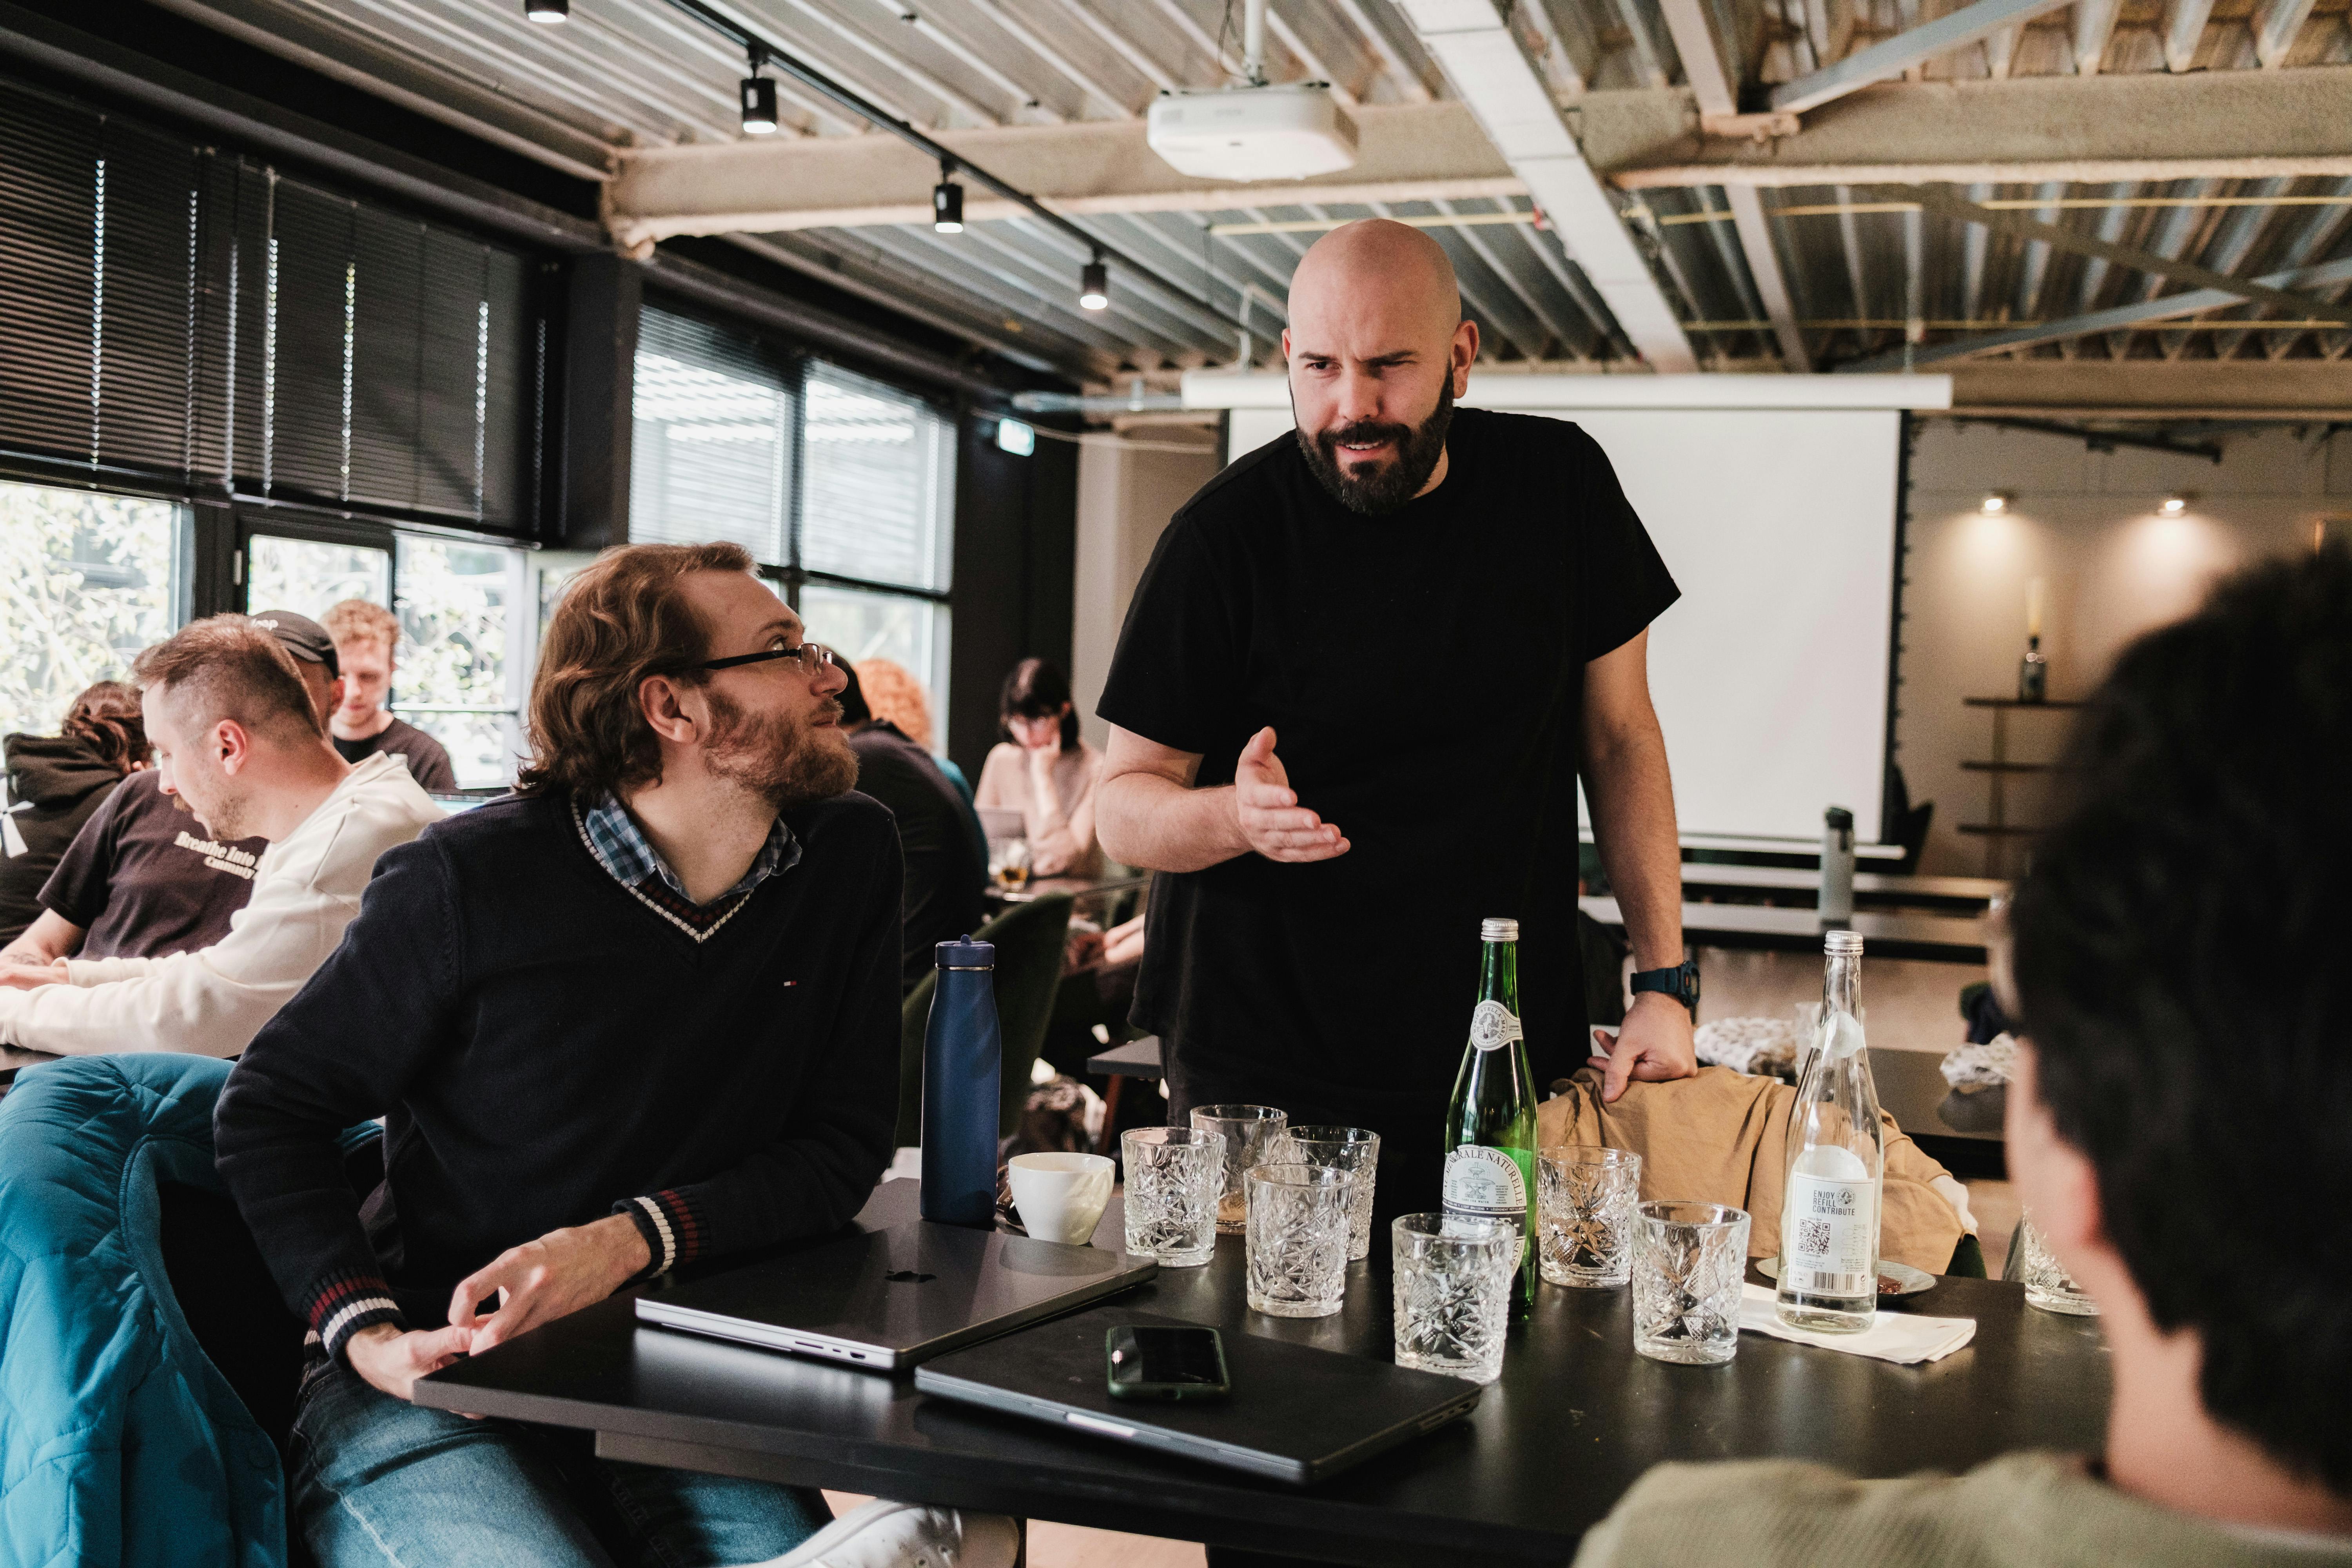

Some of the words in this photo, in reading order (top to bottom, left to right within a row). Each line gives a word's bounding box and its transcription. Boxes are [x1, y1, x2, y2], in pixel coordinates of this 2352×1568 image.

[173, 831, 228, 859] Breathe
[1485, 1151, 1523, 1205] NATURELLE
[1814, 1190, 1835, 1199] ENJOY
[1813, 1198, 1836, 1207] REFILL
[1813, 1205, 1855, 1216] CONTRIBUTE
